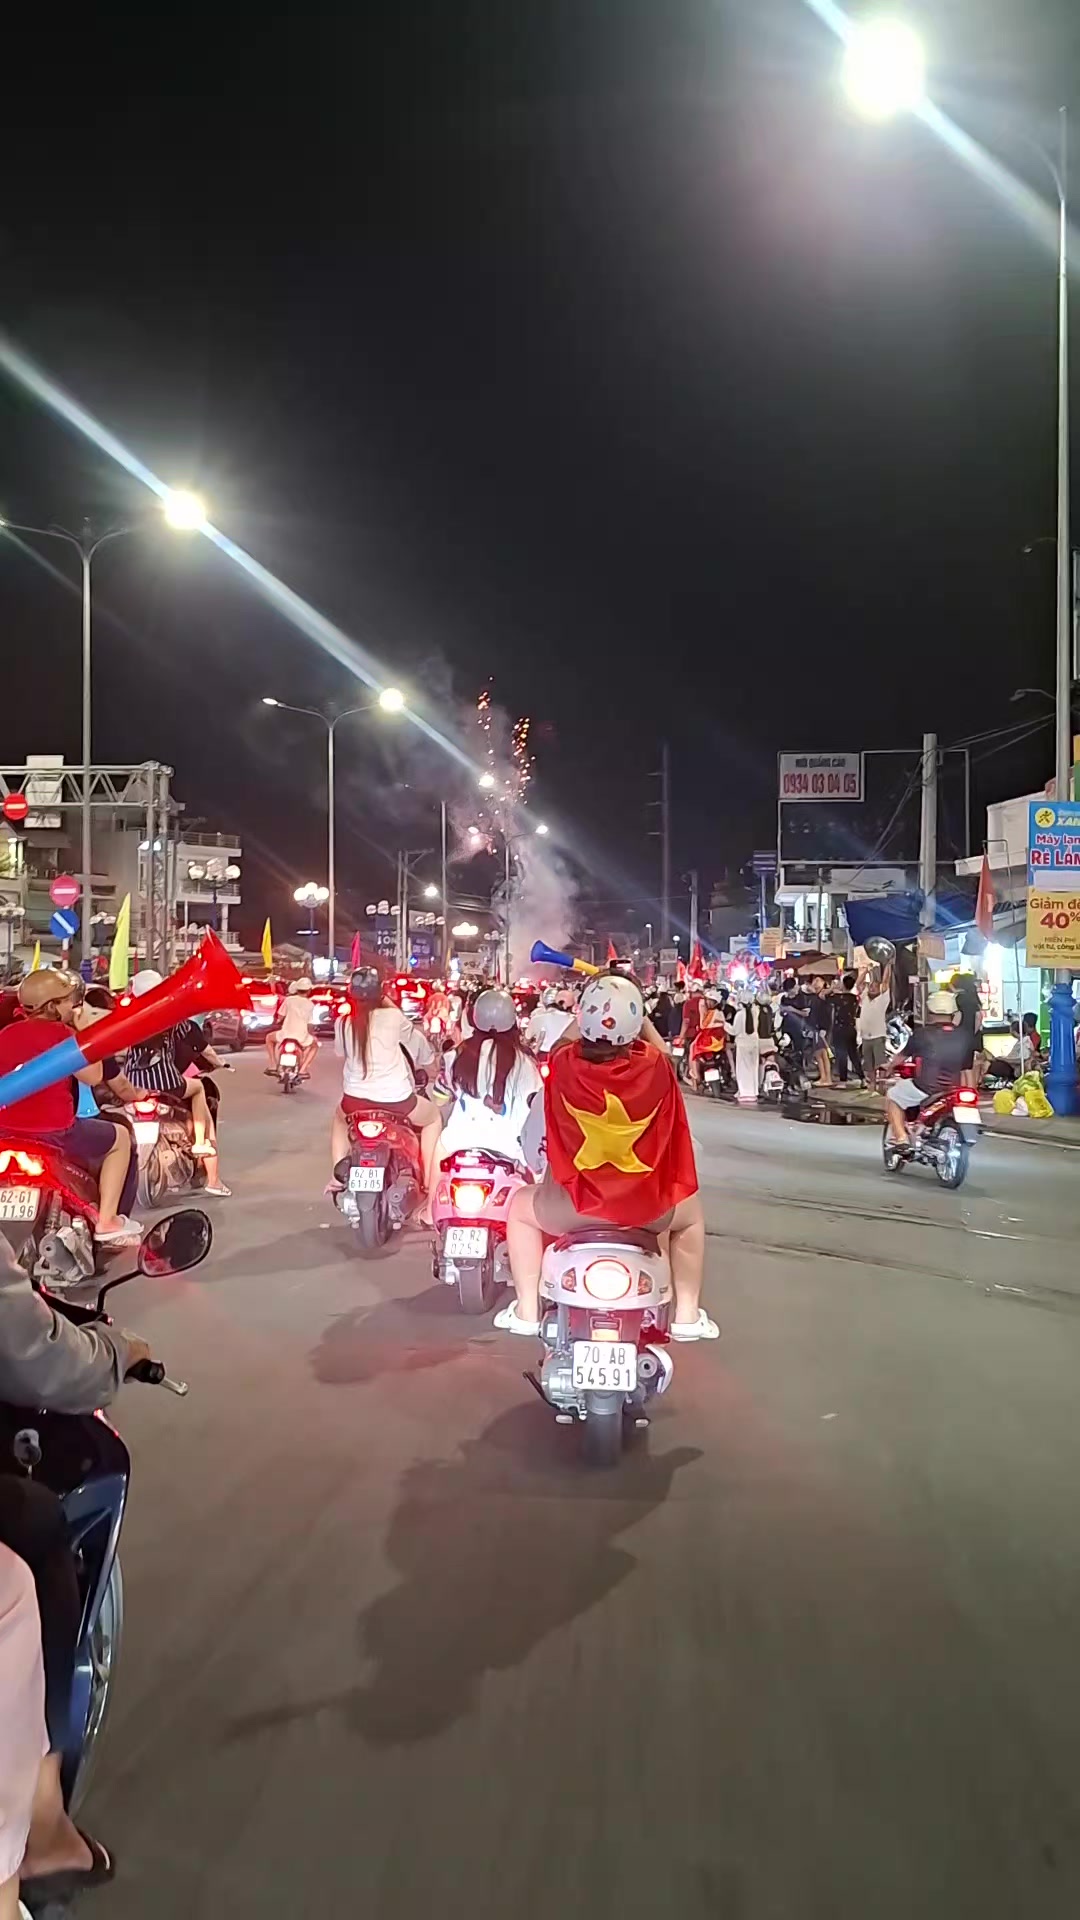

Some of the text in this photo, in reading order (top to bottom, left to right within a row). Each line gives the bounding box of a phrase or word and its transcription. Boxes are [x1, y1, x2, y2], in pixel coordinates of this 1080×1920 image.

[783, 773, 857, 793] 0934 03 04 05
[1036, 833, 1061, 846] Máy
[1029, 896, 1064, 910] Giảm
